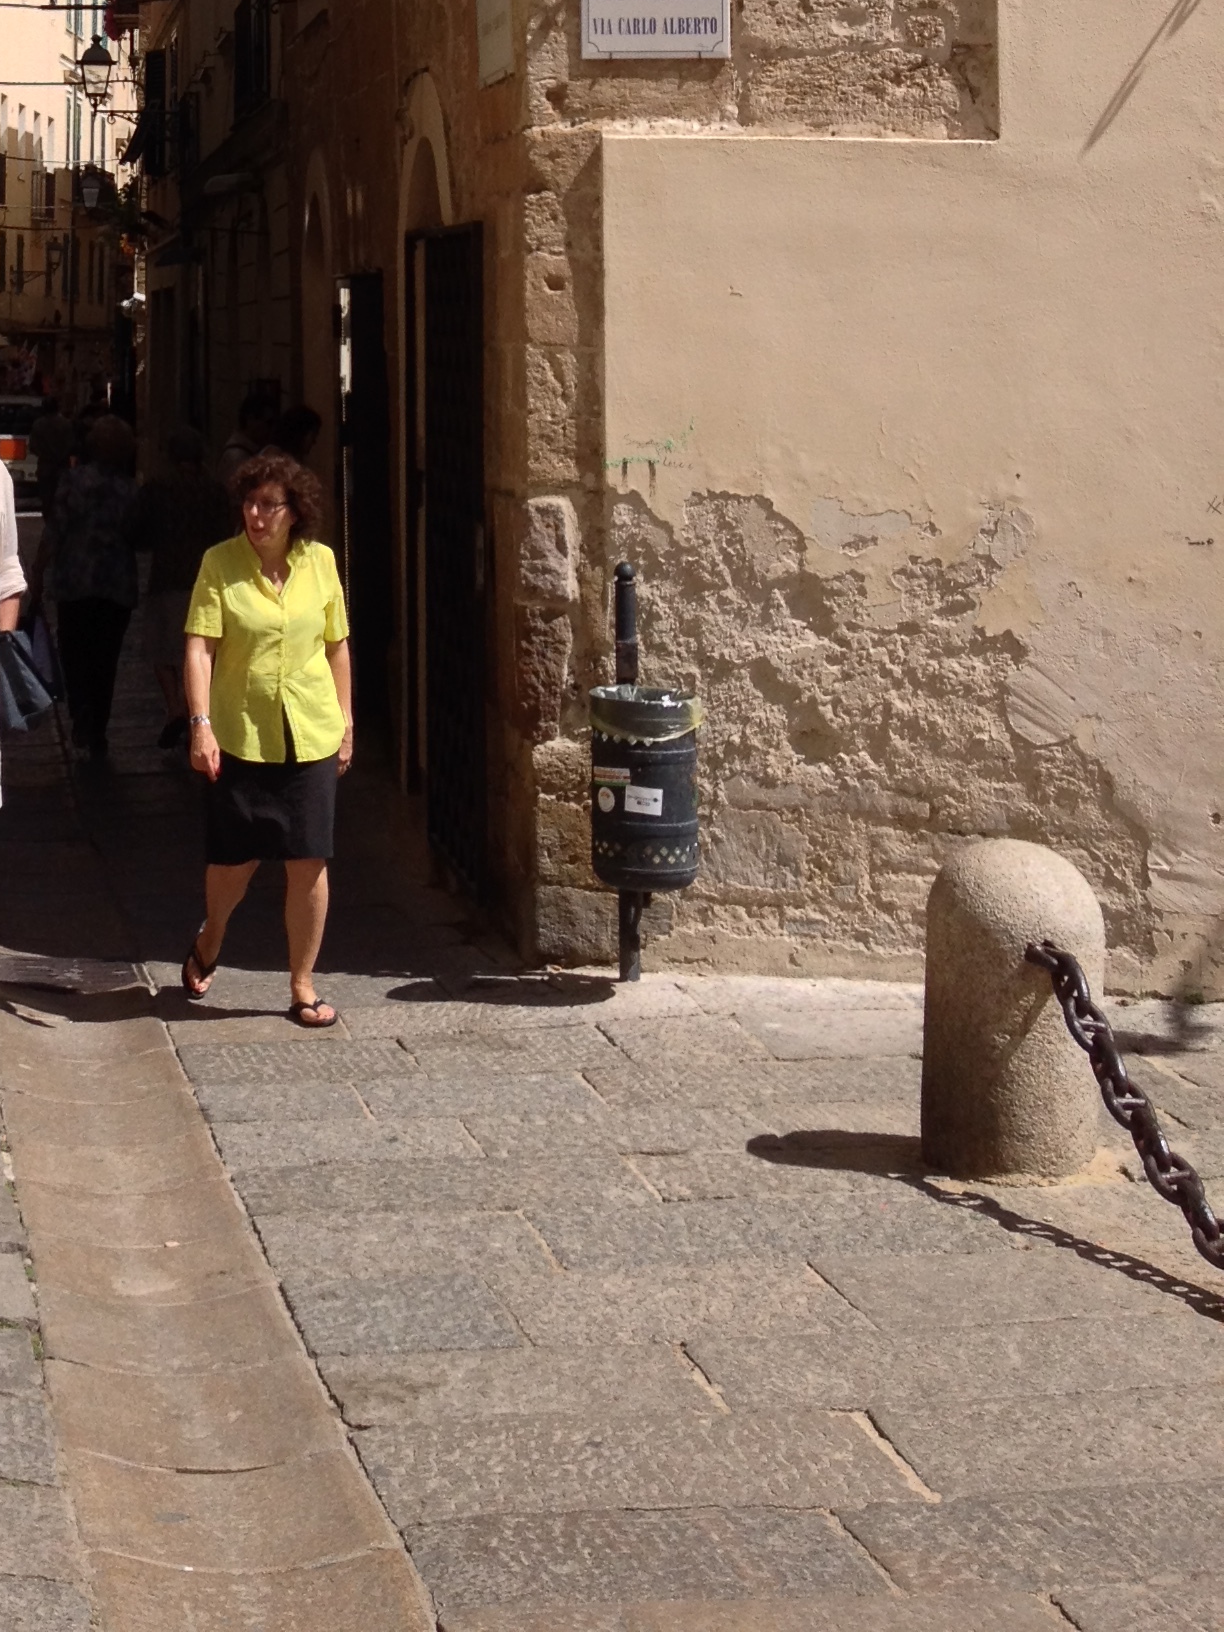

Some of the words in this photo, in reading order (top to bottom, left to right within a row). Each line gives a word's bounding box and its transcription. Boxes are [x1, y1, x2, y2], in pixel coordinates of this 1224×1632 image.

[592, 18, 613, 35] VIA
[618, 17, 657, 35] CARLO
[662, 16, 718, 35] ALBERTO
